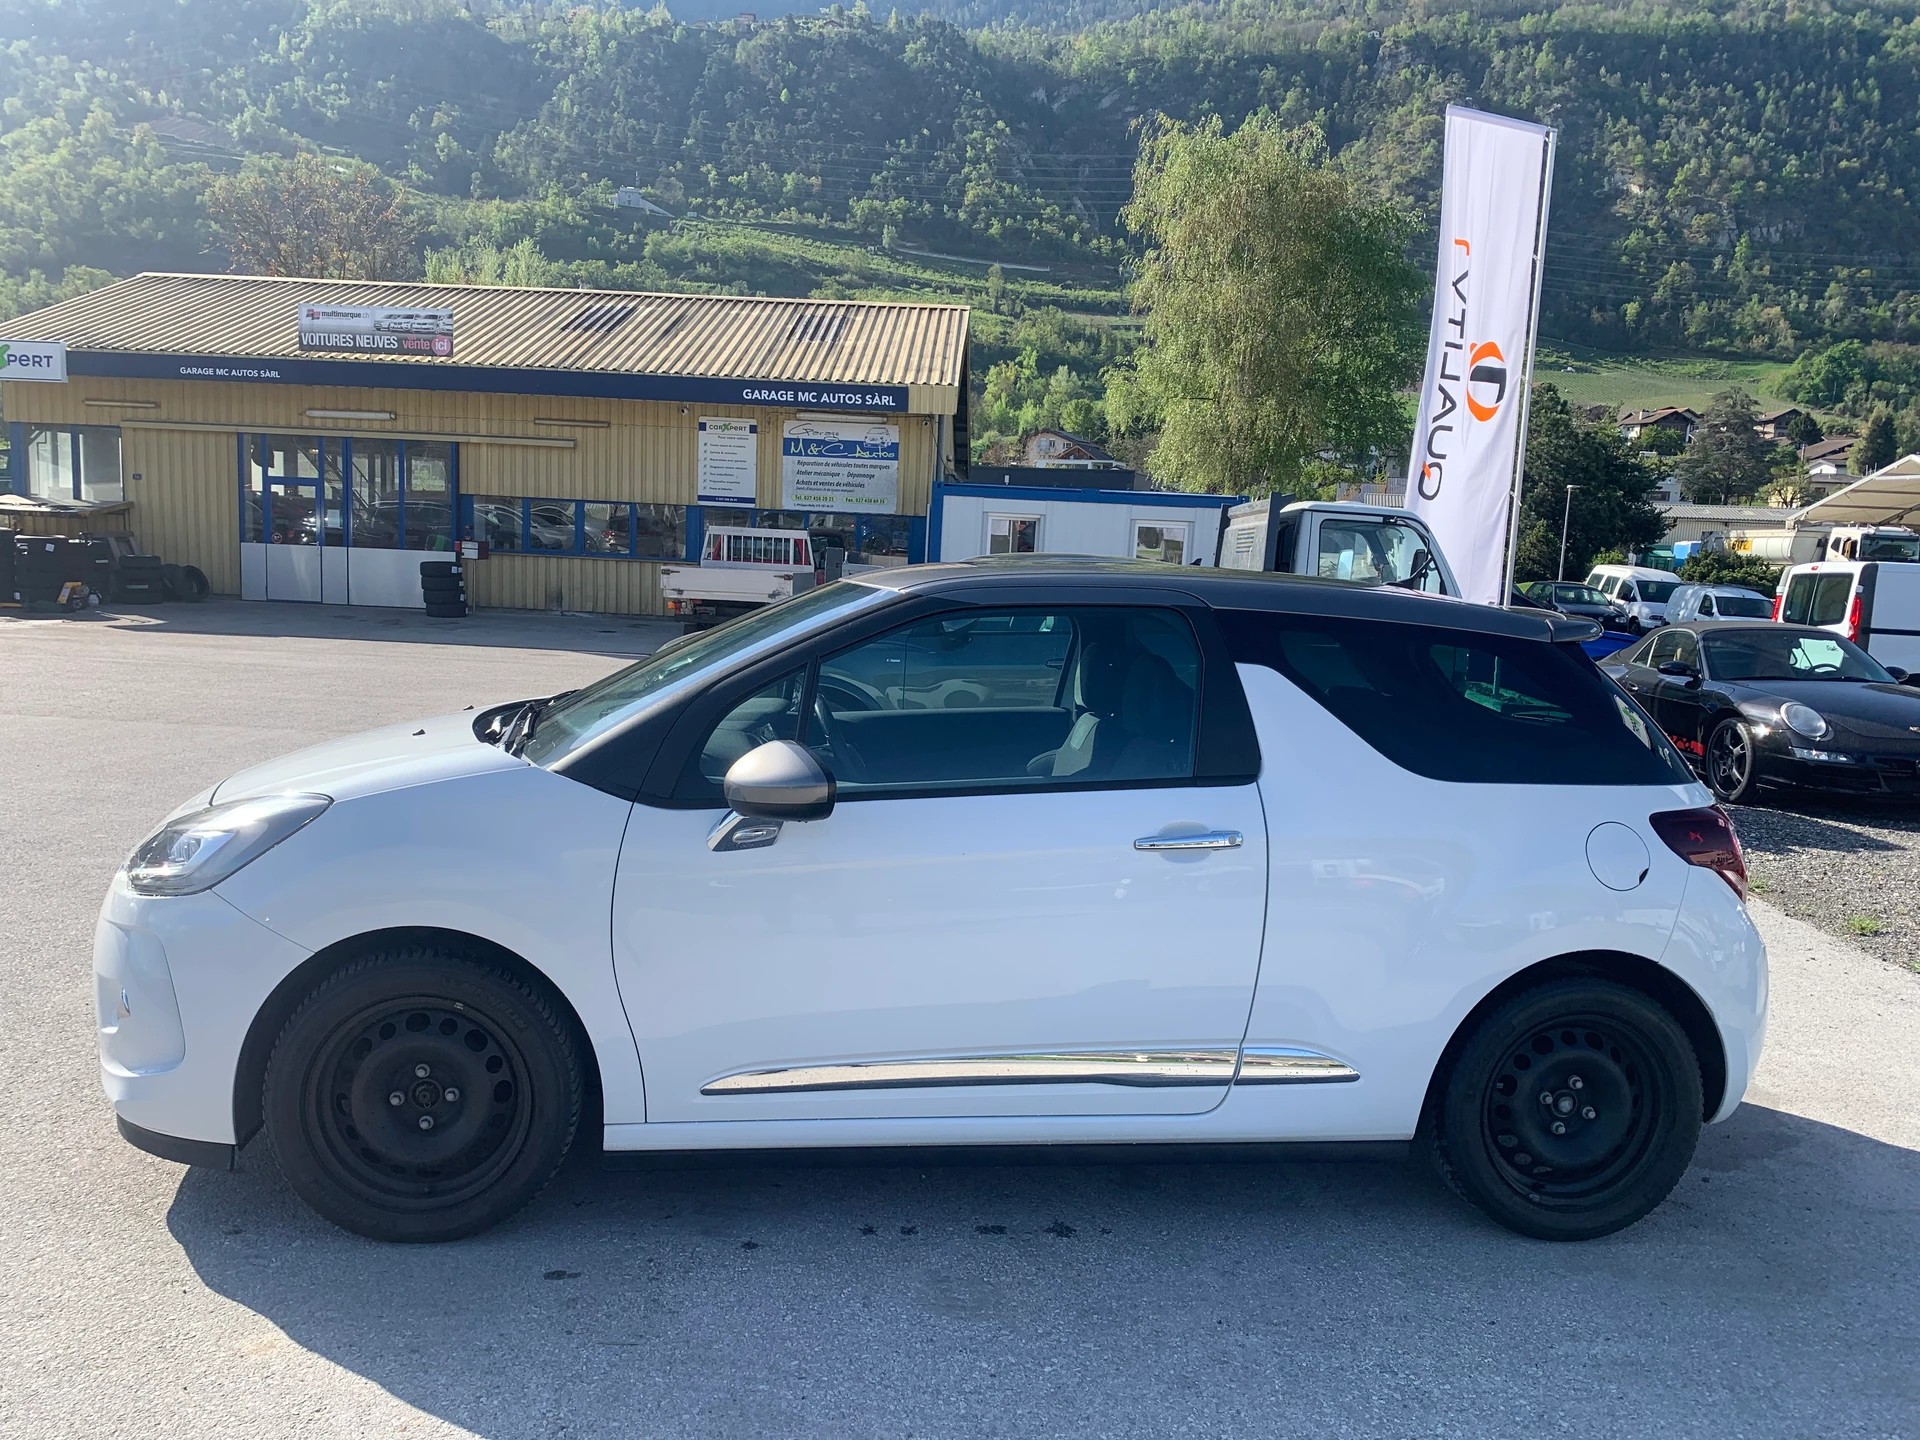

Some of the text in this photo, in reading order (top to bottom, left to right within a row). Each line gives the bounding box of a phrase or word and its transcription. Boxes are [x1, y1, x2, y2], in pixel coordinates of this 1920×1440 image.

[301, 333, 353, 347] VOITURES
[356, 335, 398, 349] NEUVES
[402, 338, 430, 350] vente
[435, 338, 447, 350] ici
[180, 367, 281, 378] GARAGE MC AUTOS SÀRL
[743, 389, 896, 406] GARAGE MC AUTOS SÀRL
[797, 460, 823, 468] Réparation
